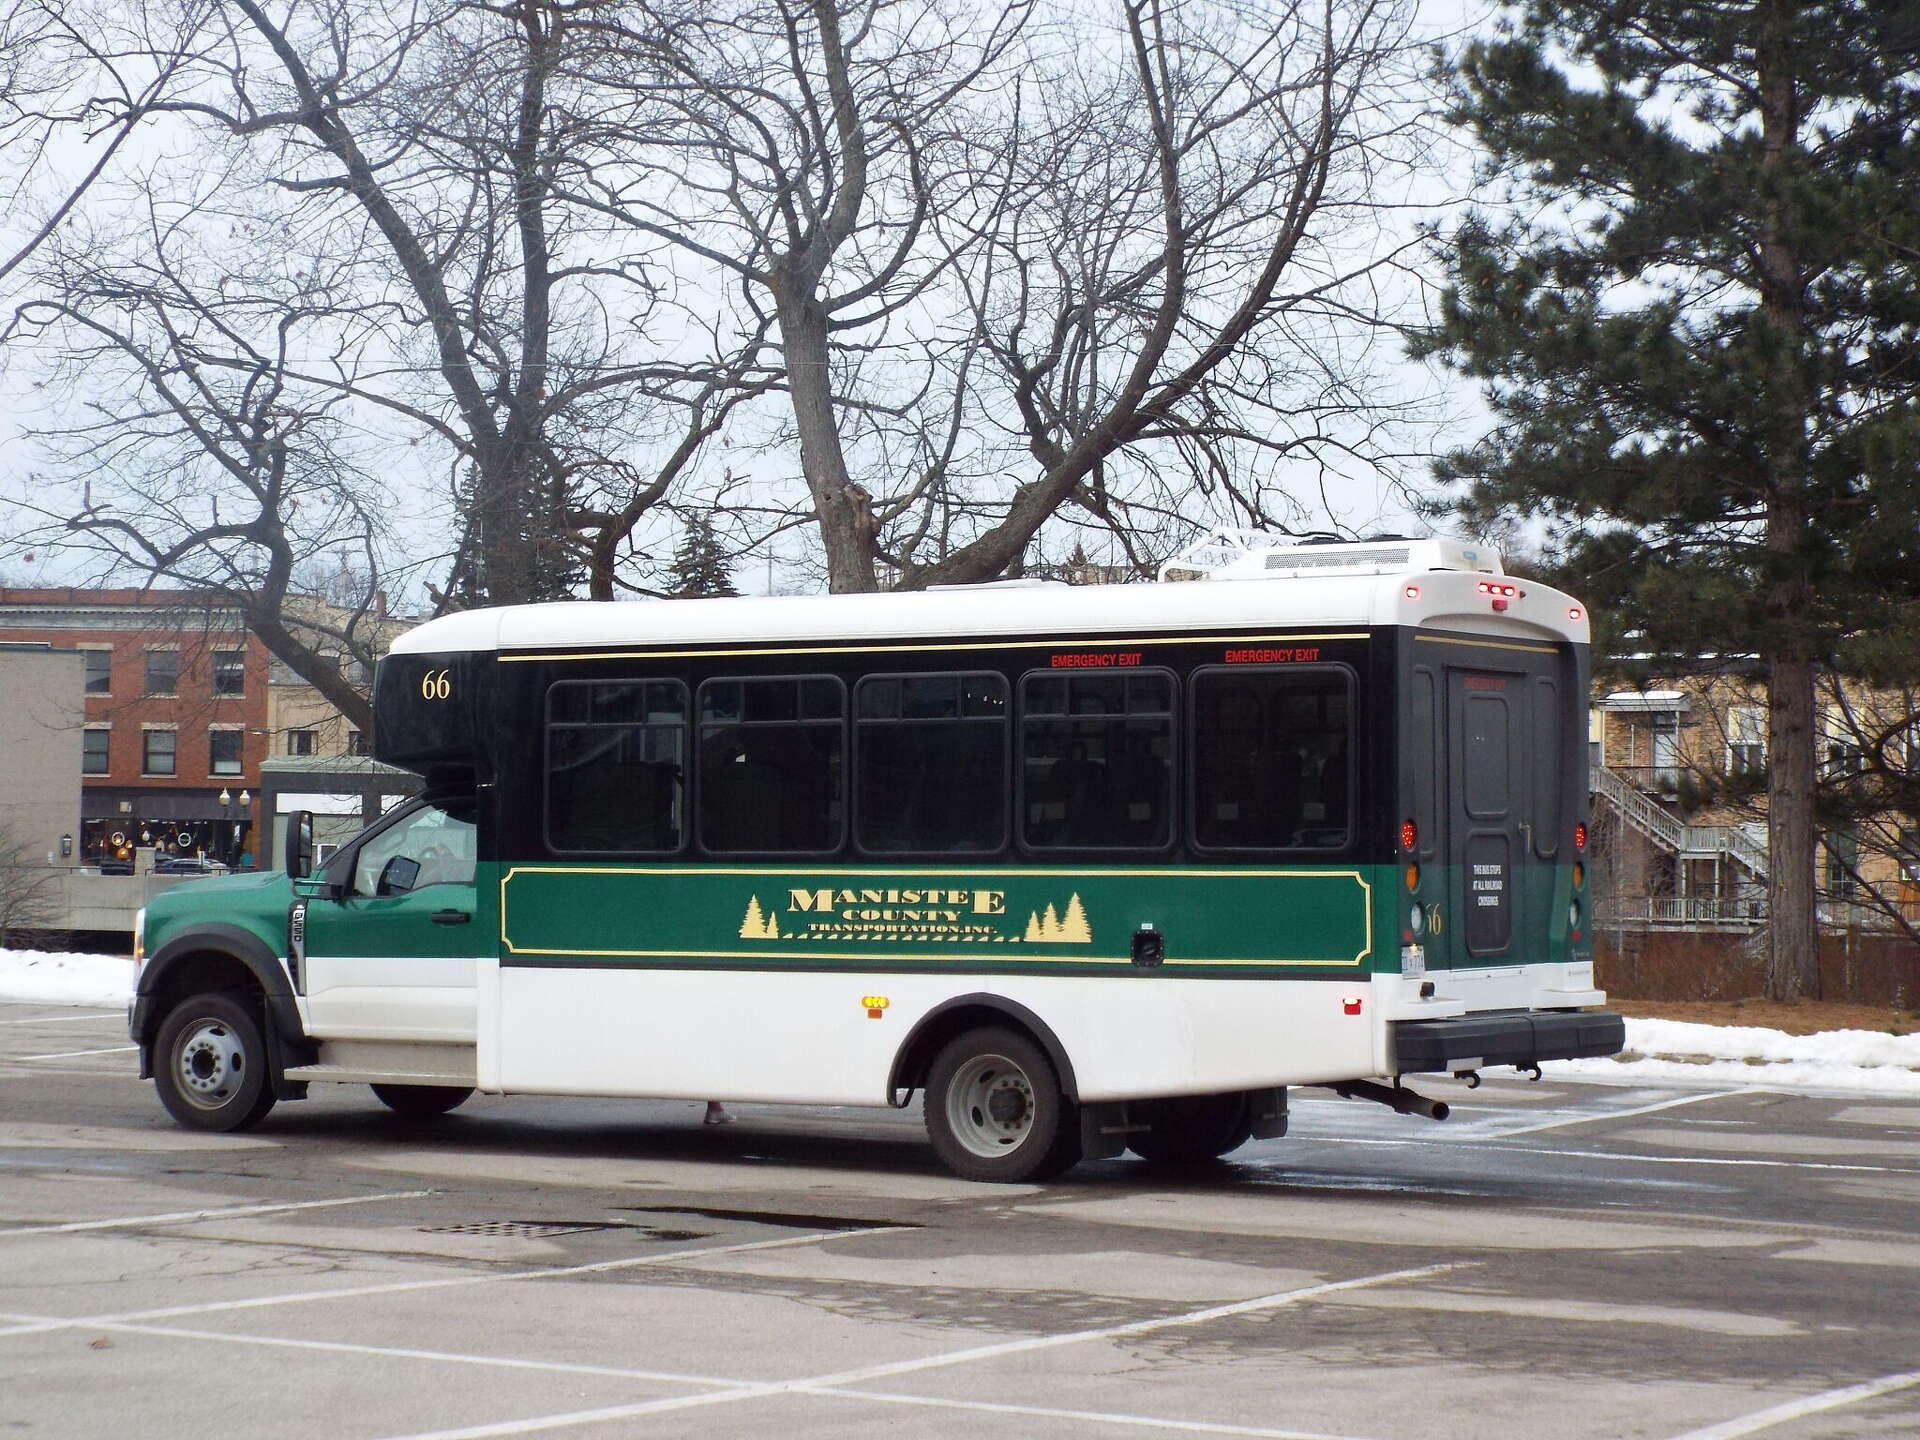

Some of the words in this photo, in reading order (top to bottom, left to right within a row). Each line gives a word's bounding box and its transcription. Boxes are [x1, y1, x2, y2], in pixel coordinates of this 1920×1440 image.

[1051, 654, 1117, 667] EMERGENCY
[1119, 652, 1142, 665] EXIT
[1224, 649, 1293, 663] EMERGENCY
[1295, 648, 1320, 661] EXIT
[422, 669, 451, 700] 66
[787, 889, 1005, 914] MANISTEE
[842, 909, 961, 922] COUNTY
